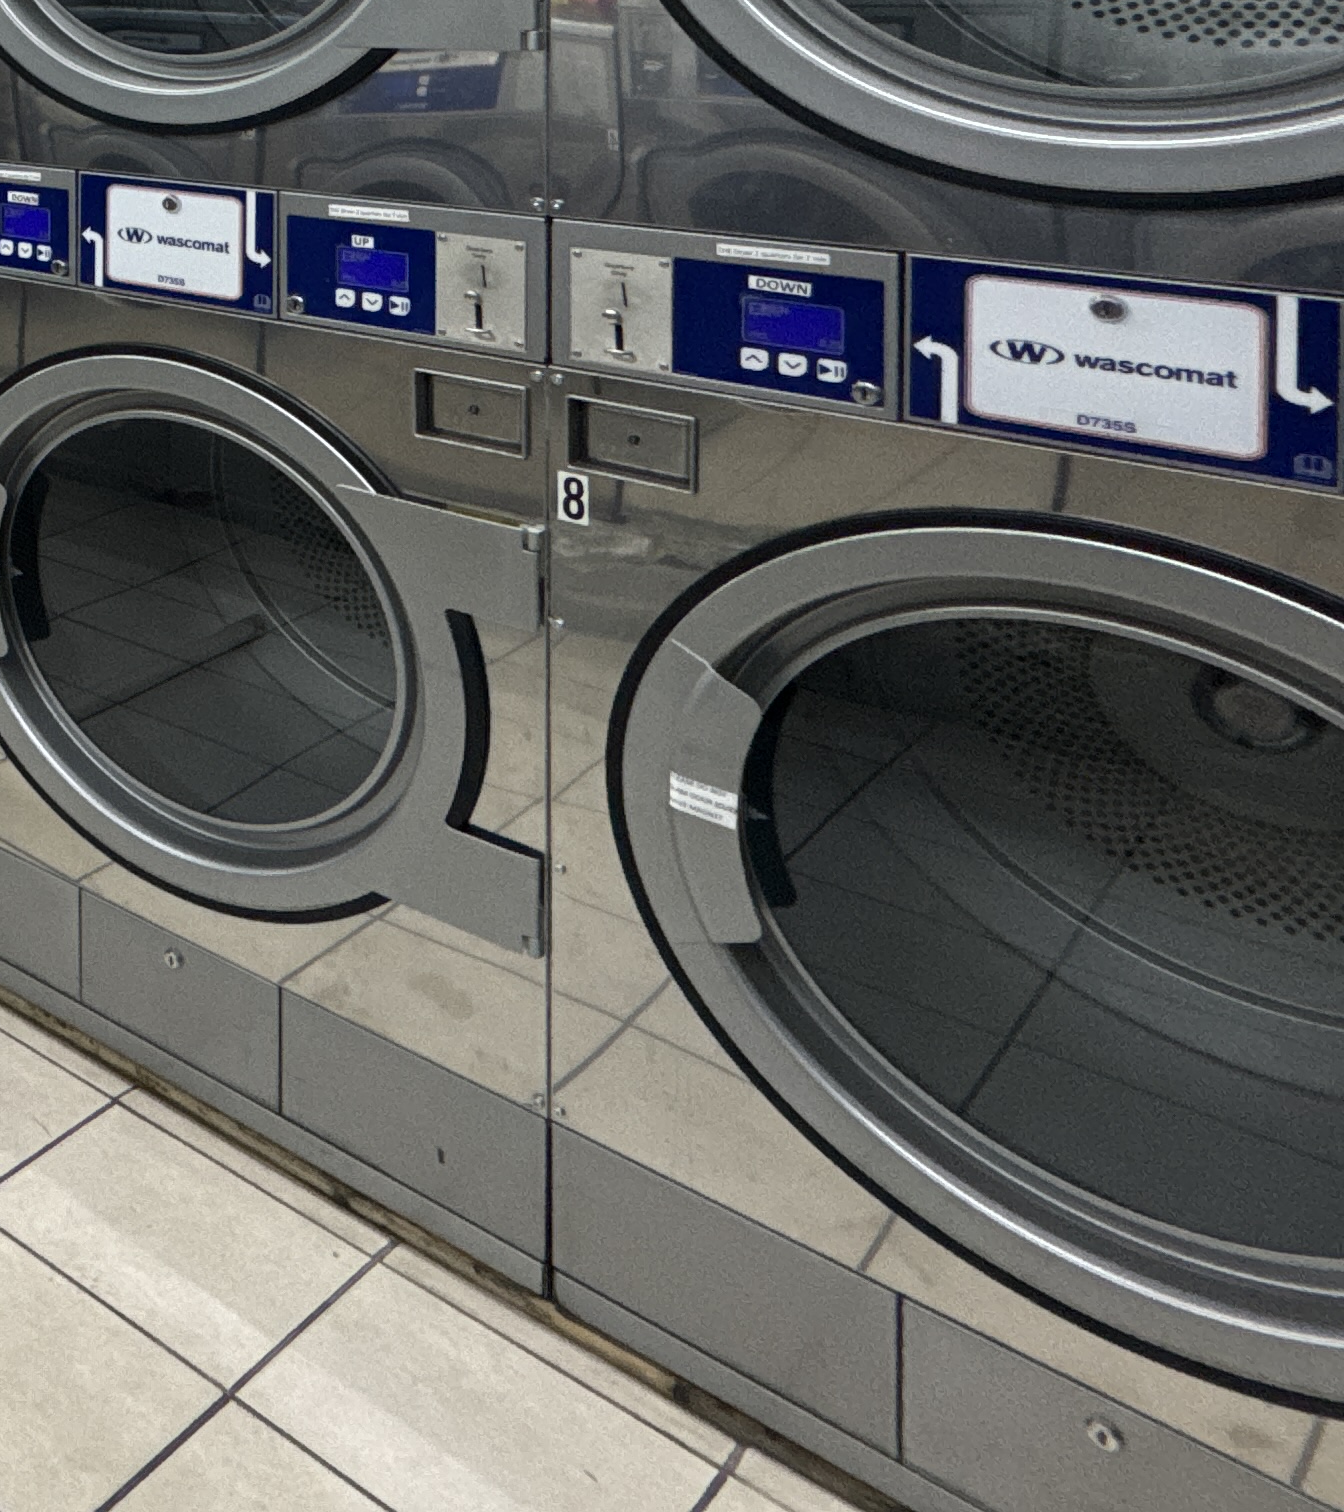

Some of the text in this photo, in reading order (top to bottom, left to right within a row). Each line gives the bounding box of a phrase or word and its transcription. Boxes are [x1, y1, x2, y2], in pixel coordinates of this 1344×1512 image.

[156, 234, 230, 255] wascomat
[353, 236, 370, 247] UP
[755, 277, 809, 295] DOWN
[1074, 352, 1239, 390] wascomat
[1076, 413, 1138, 434] D735S
[562, 476, 585, 521] 8
